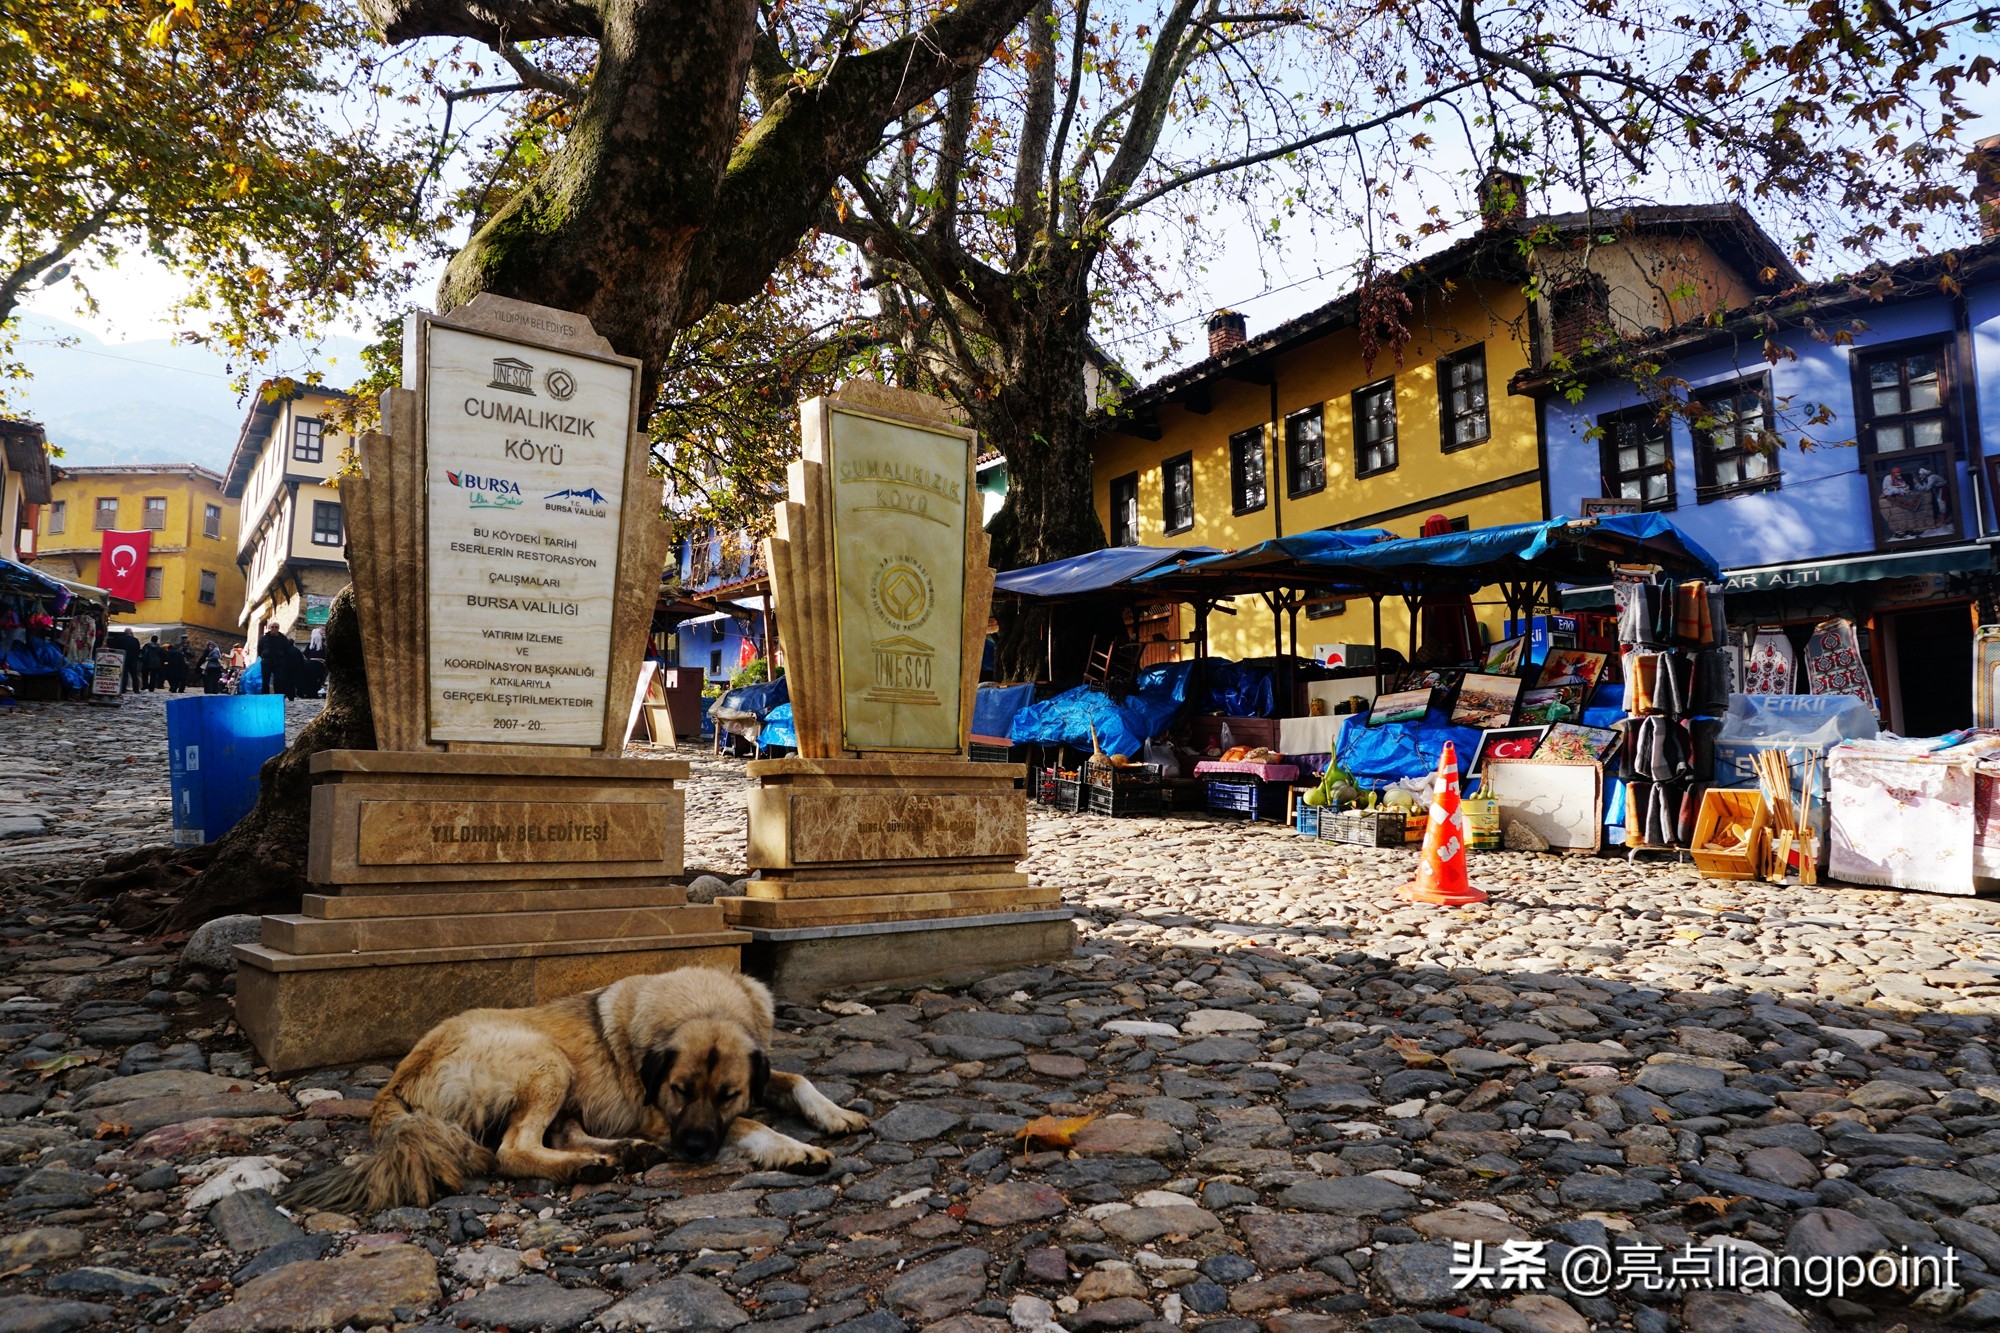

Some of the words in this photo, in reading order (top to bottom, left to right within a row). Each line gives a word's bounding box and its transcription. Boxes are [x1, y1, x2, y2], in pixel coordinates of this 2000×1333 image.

[493, 310, 530, 326] YILDIRIM
[493, 364, 532, 388] UNESCO
[464, 397, 596, 439] CUMALIKIZIK
[504, 438, 564, 466] KÖYÜ
[465, 474, 521, 496] BURSA
[840, 460, 961, 499] CUMALIKIZIK
[545, 503, 573, 515] BURSA
[473, 528, 490, 538] BU
[492, 530, 541, 545] KÖYDEKİ
[543, 537, 578, 549] TARİHİ
[450, 542, 514, 558] ESERLERİN
[516, 550, 597, 568] RESTORASYON
[488, 572, 560, 588] ÇALIŞMALARI
[1768, 570, 1820, 586] ALTI
[466, 595, 519, 611] BURSA
[521, 600, 579, 616] VALİLİĞİ
[481, 629, 524, 642] YATIRIM
[526, 631, 563, 645] İZLEME
[516, 647, 529, 656] VE
[444, 658, 532, 673] KOORDİNASYON
[534, 665, 595, 678] BAŞKANLIĞI
[875, 653, 931, 689] UNESCO
[490, 677, 551, 689] KATKILARIYLA
[442, 690, 593, 708] GERÇEKLEŞTİRİLMEKTEDİR
[1763, 695, 1827, 713] Erikli
[493, 719, 518, 730] 2007
[431, 825, 512, 843] YILDIRIM
[516, 821, 609, 842] BELEDİYESİ
